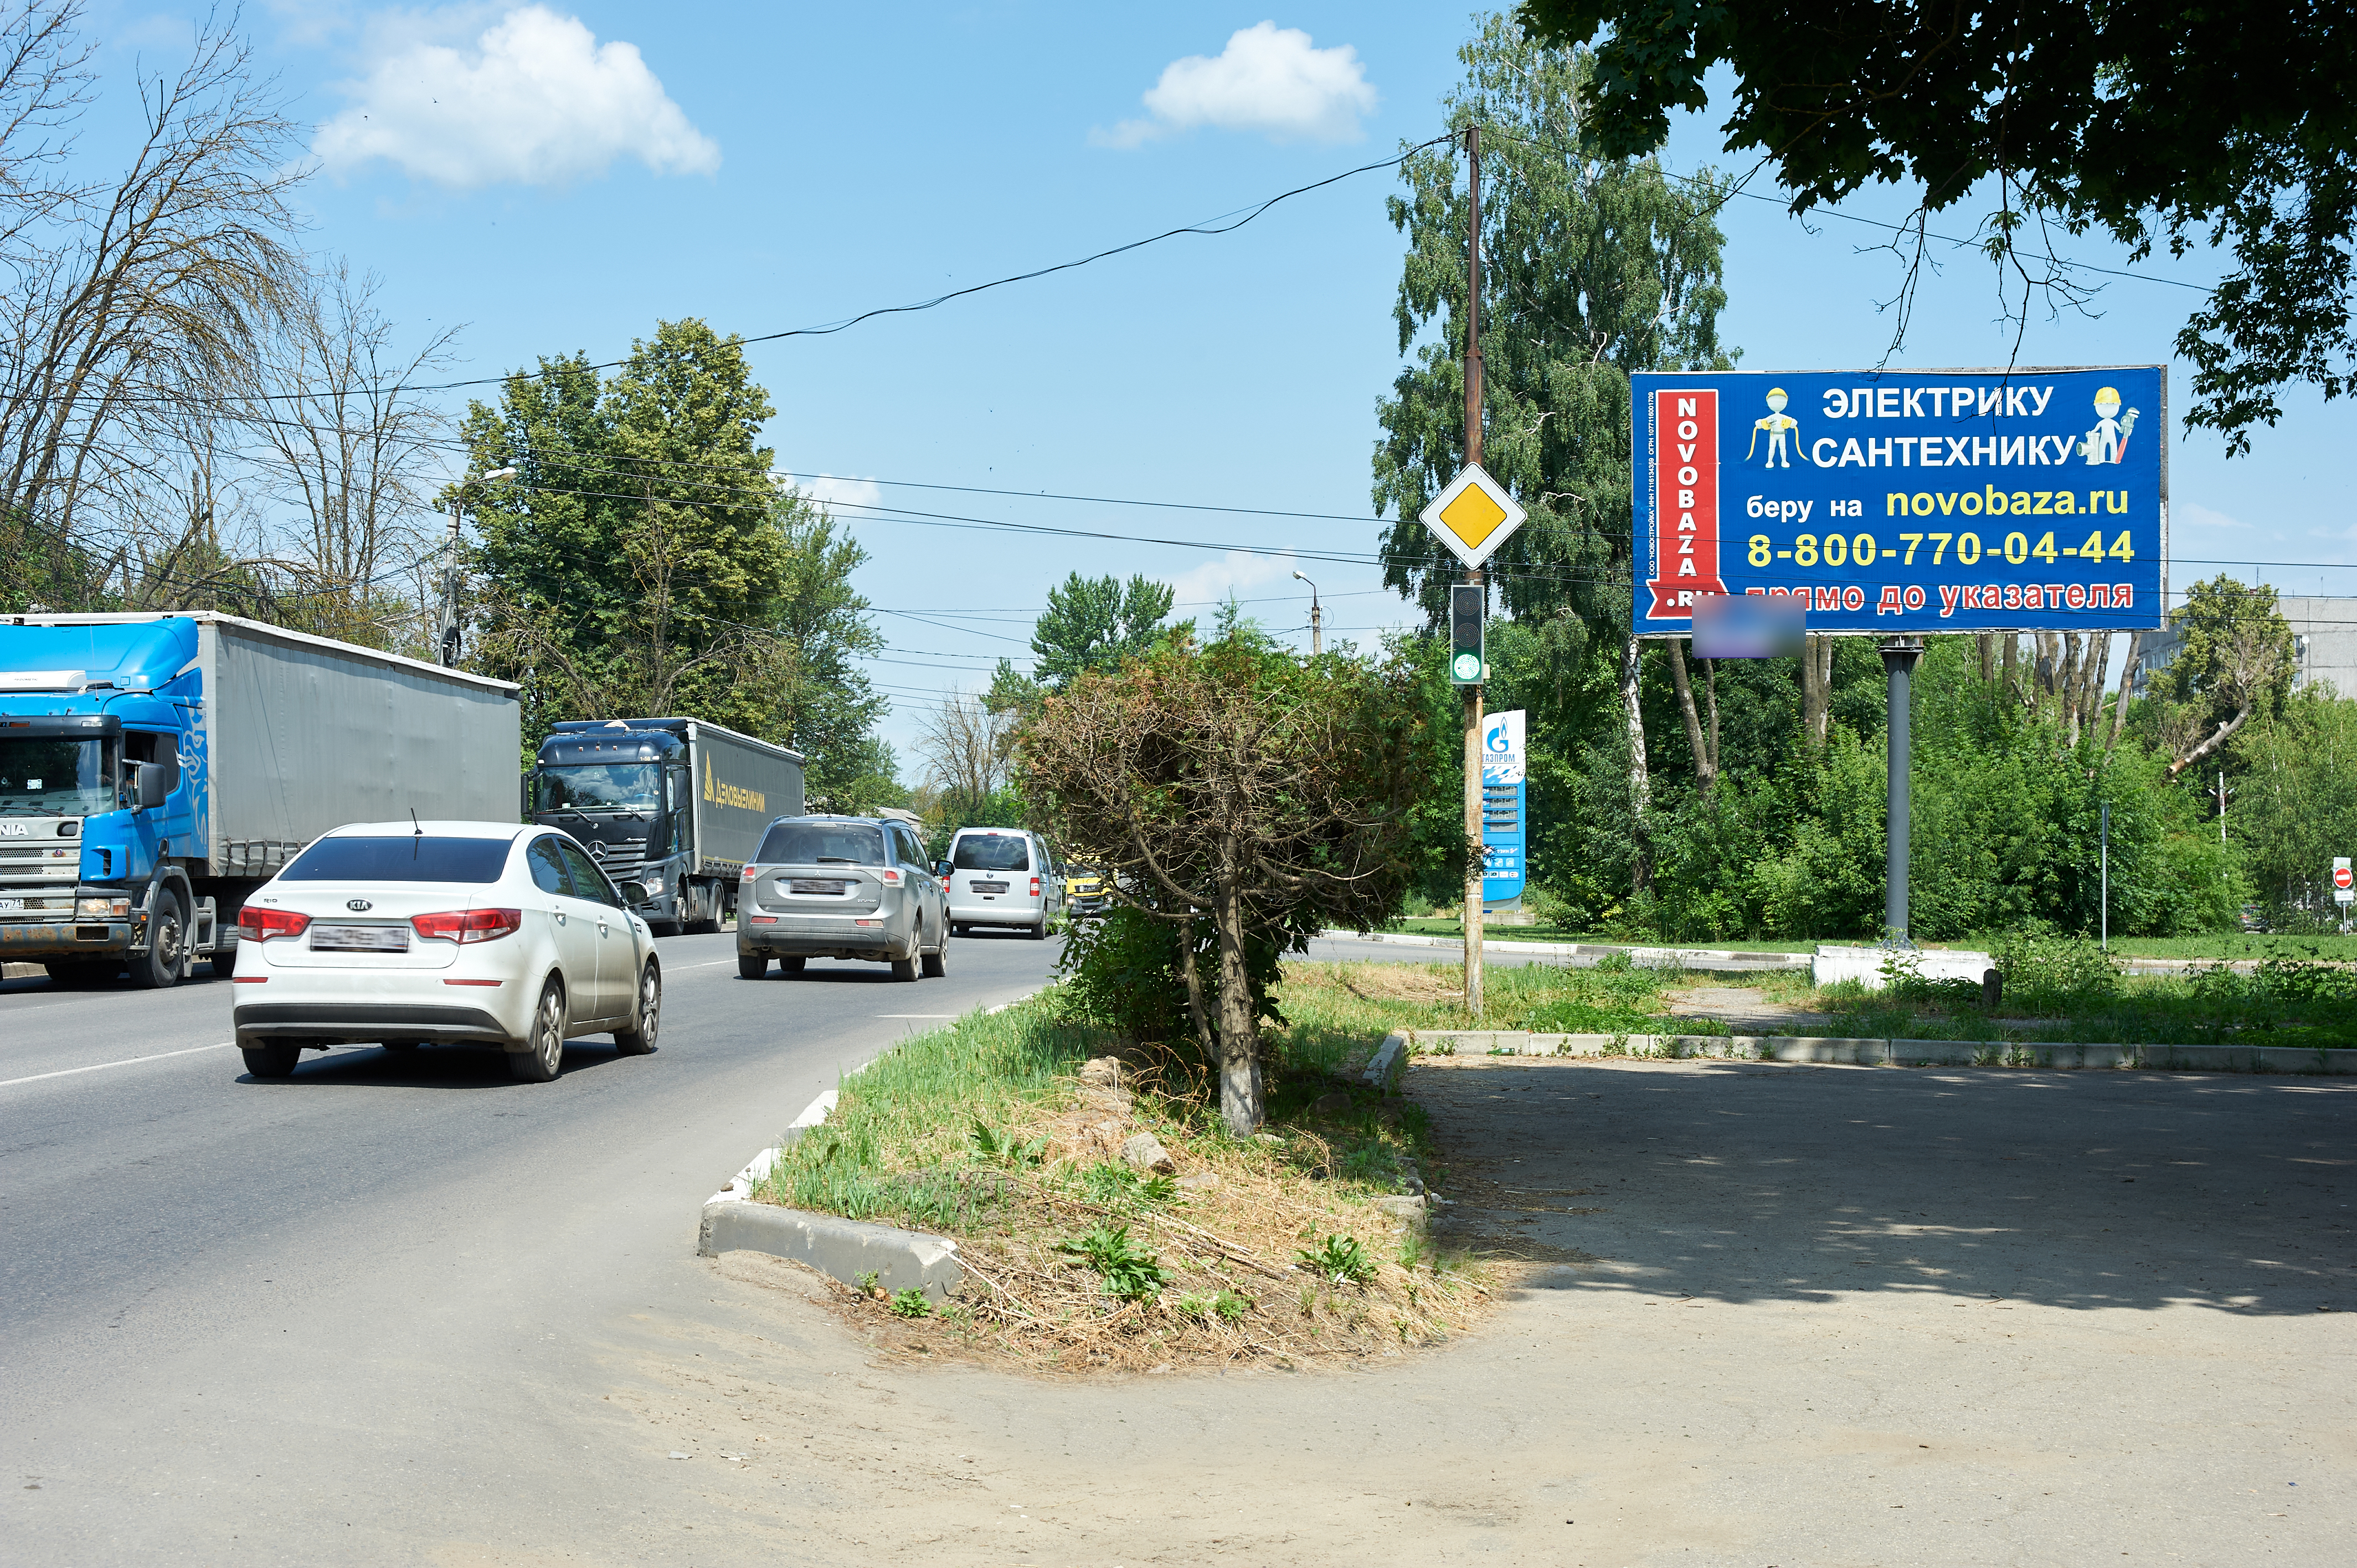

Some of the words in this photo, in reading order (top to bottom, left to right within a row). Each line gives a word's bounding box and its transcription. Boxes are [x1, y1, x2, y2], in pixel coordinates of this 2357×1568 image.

[1823, 386, 2054, 418] ЭЛЕКТРИКУ
[1812, 435, 2076, 467] САНТЕХНИКУ
[1677, 398, 1698, 576] NOVOBAZA
[1747, 495, 1814, 523] беру
[1830, 499, 1862, 517] на
[1887, 484, 2128, 516] novobaza.ru
[1748, 530, 2134, 566] 8-800-770-04-44
[1666, 591, 1715, 607] .R
[1877, 585, 1926, 615] до
[1938, 584, 2133, 618] указателя
[349, 901, 369, 910] KIA
